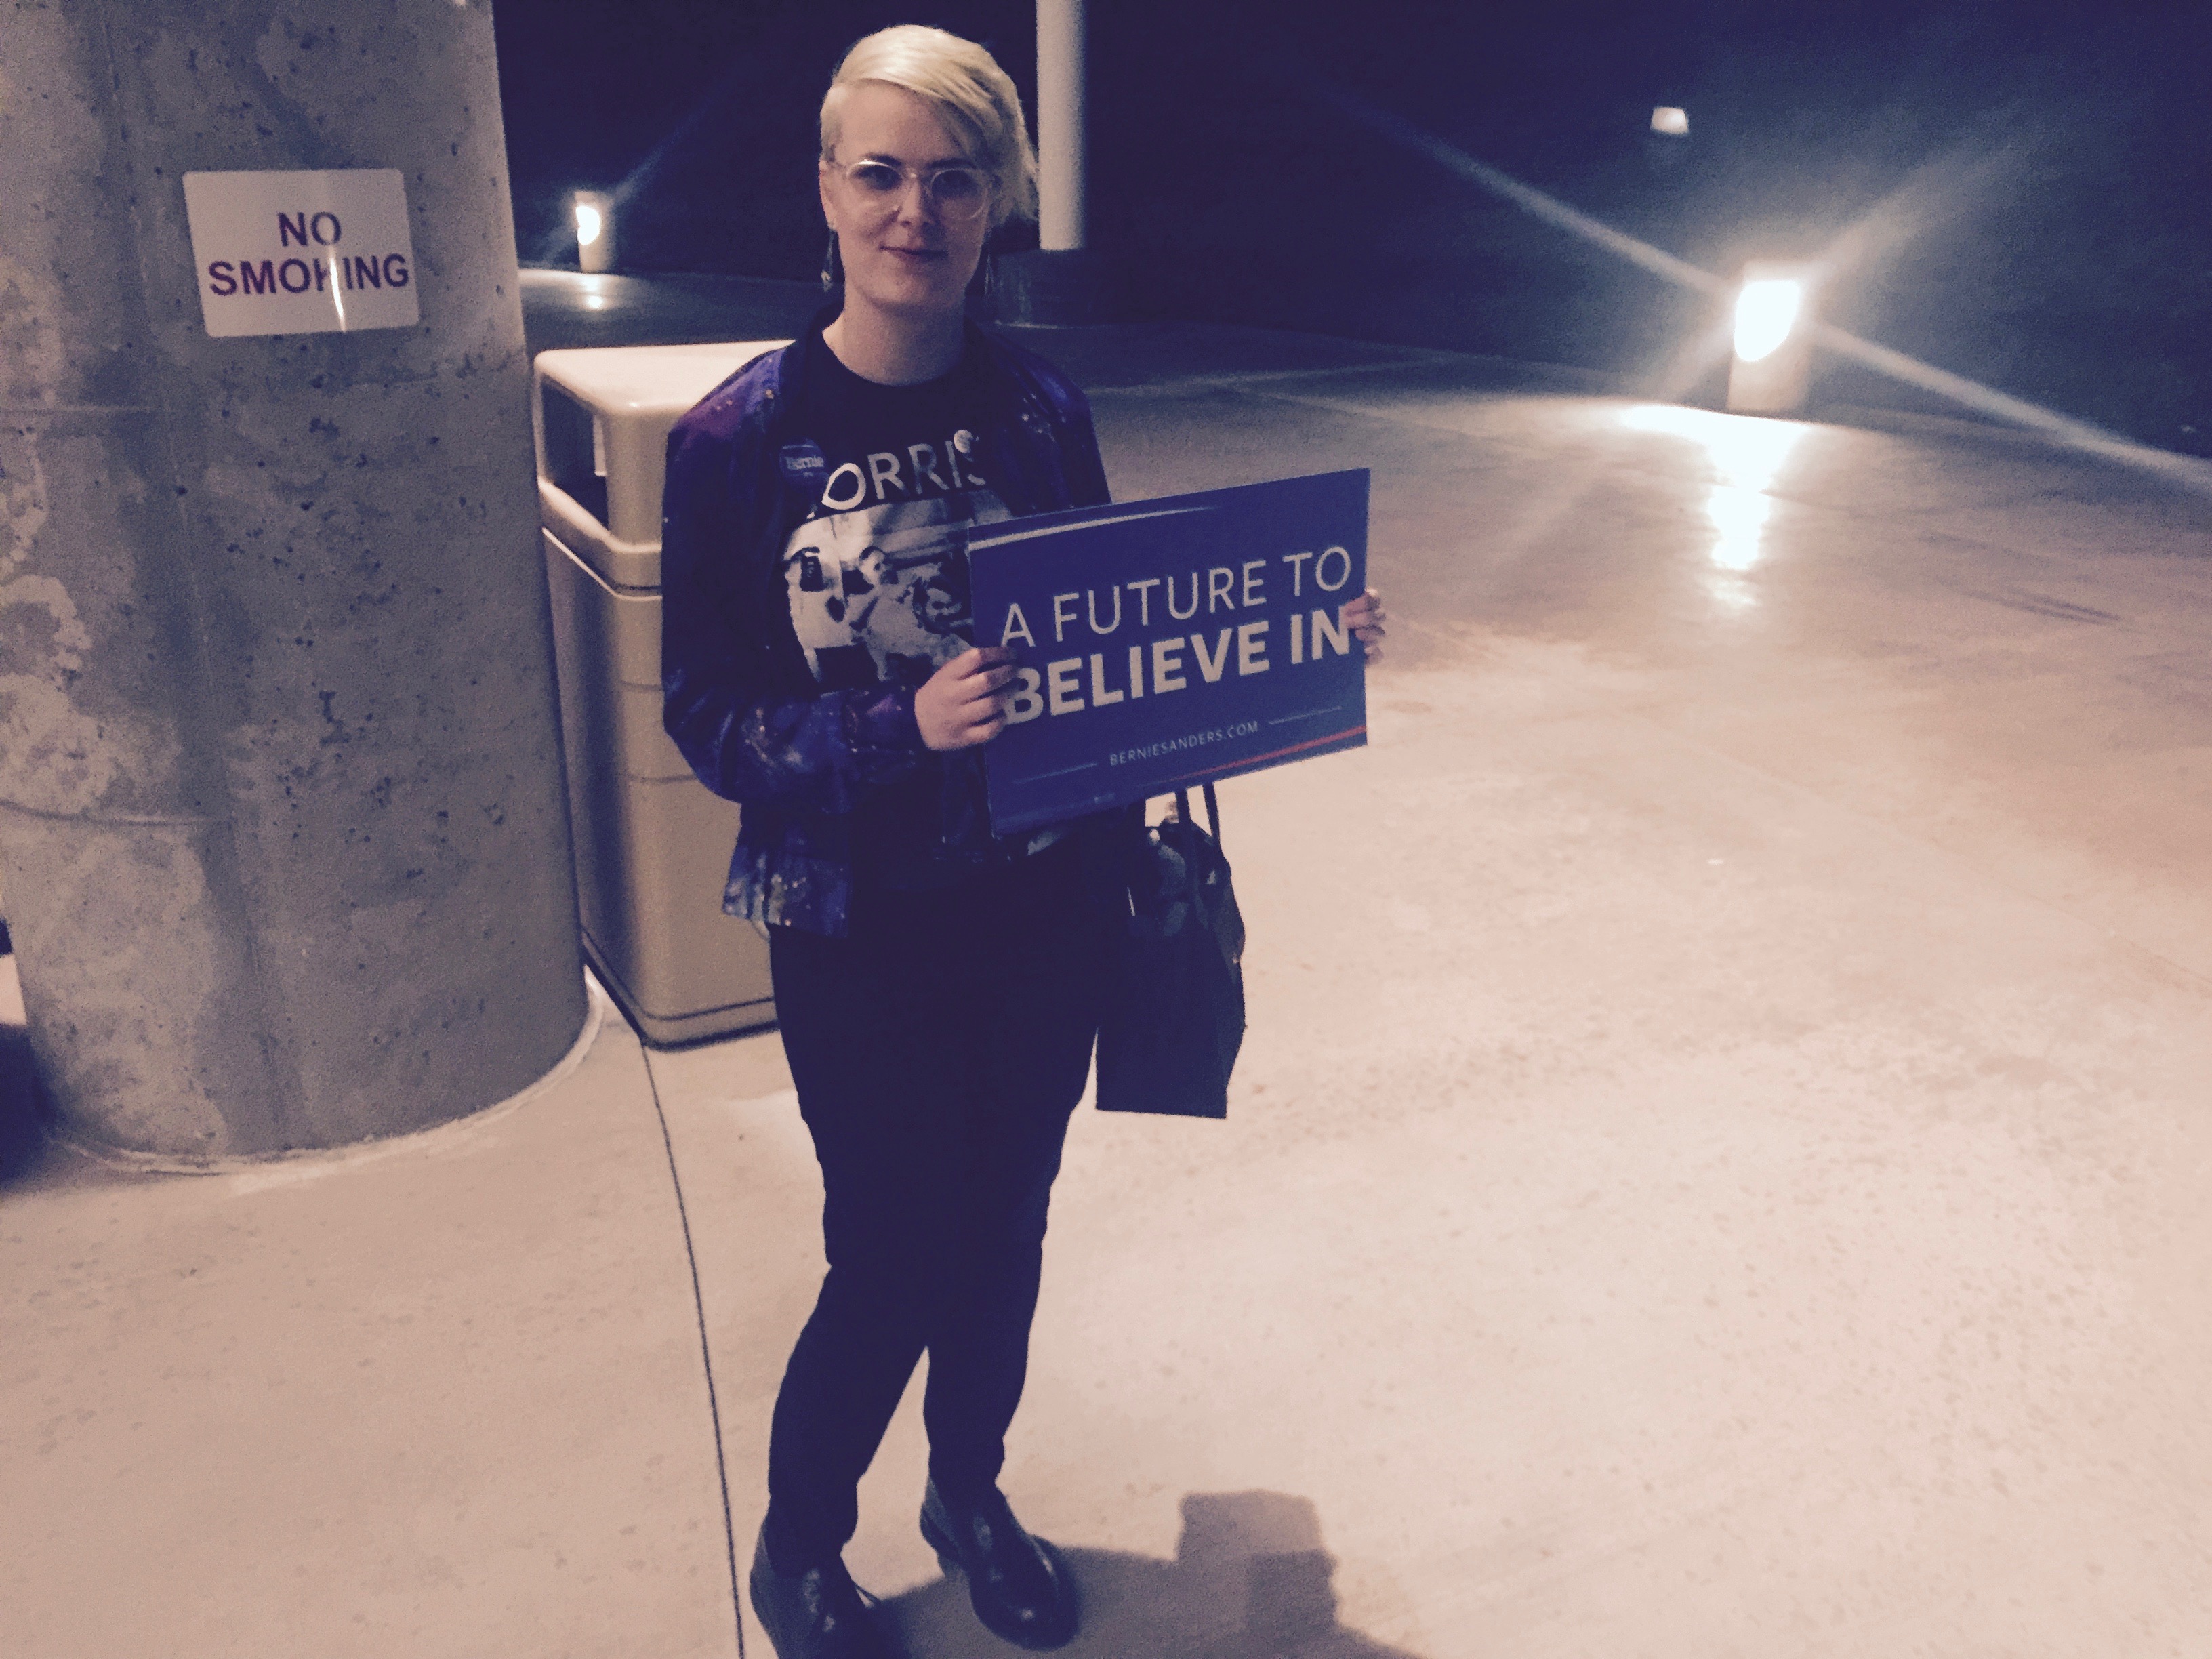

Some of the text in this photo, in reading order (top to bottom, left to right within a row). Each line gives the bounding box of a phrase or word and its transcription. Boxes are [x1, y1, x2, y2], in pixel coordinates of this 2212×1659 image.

[276, 211, 342, 247] NO
[208, 253, 409, 296] SMOKING
[1001, 546, 1351, 647] A FUTURE TO
[1003, 605, 1350, 726] BELIEVE IN
[1109, 720, 1258, 766] BERNIESANDERS.COM
